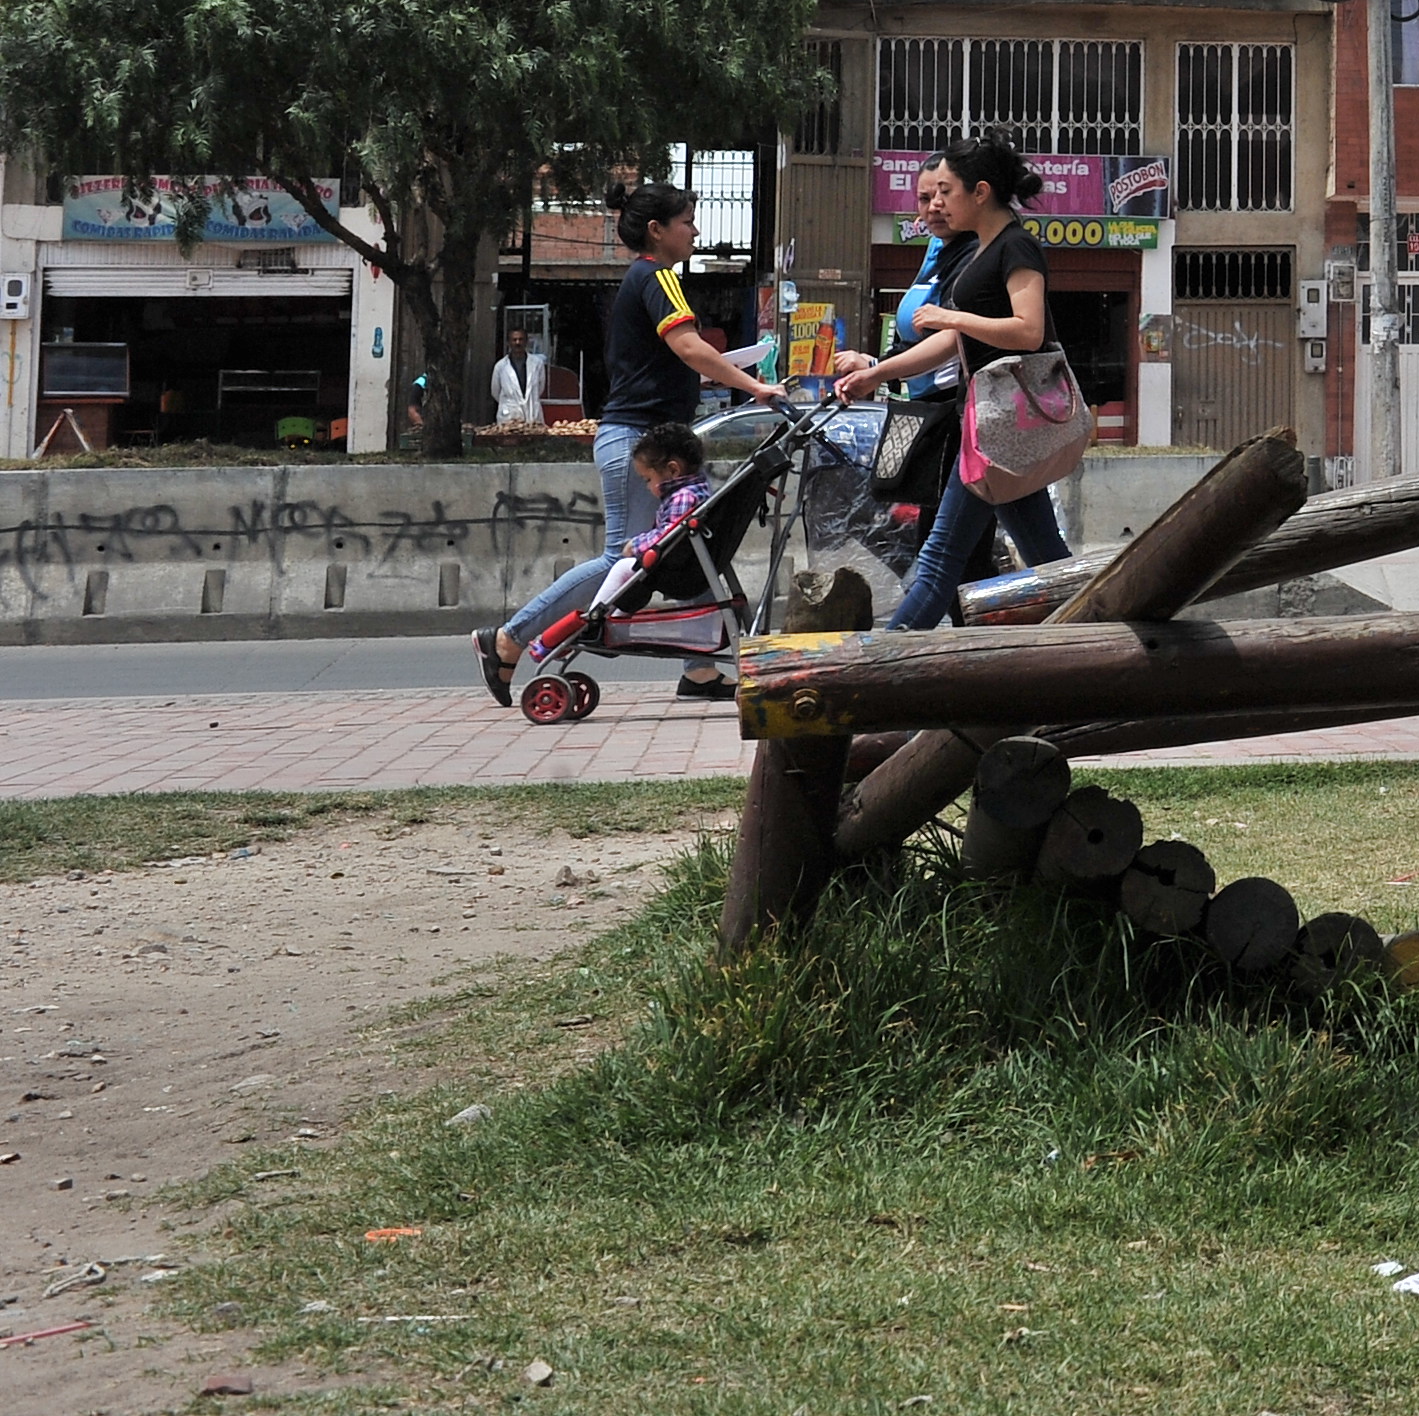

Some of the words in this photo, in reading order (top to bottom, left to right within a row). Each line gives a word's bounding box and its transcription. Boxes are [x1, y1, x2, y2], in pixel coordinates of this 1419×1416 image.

[873, 156, 924, 172] Pana
[890, 174, 911, 191] El
[1109, 163, 1165, 202] POSTOBON
